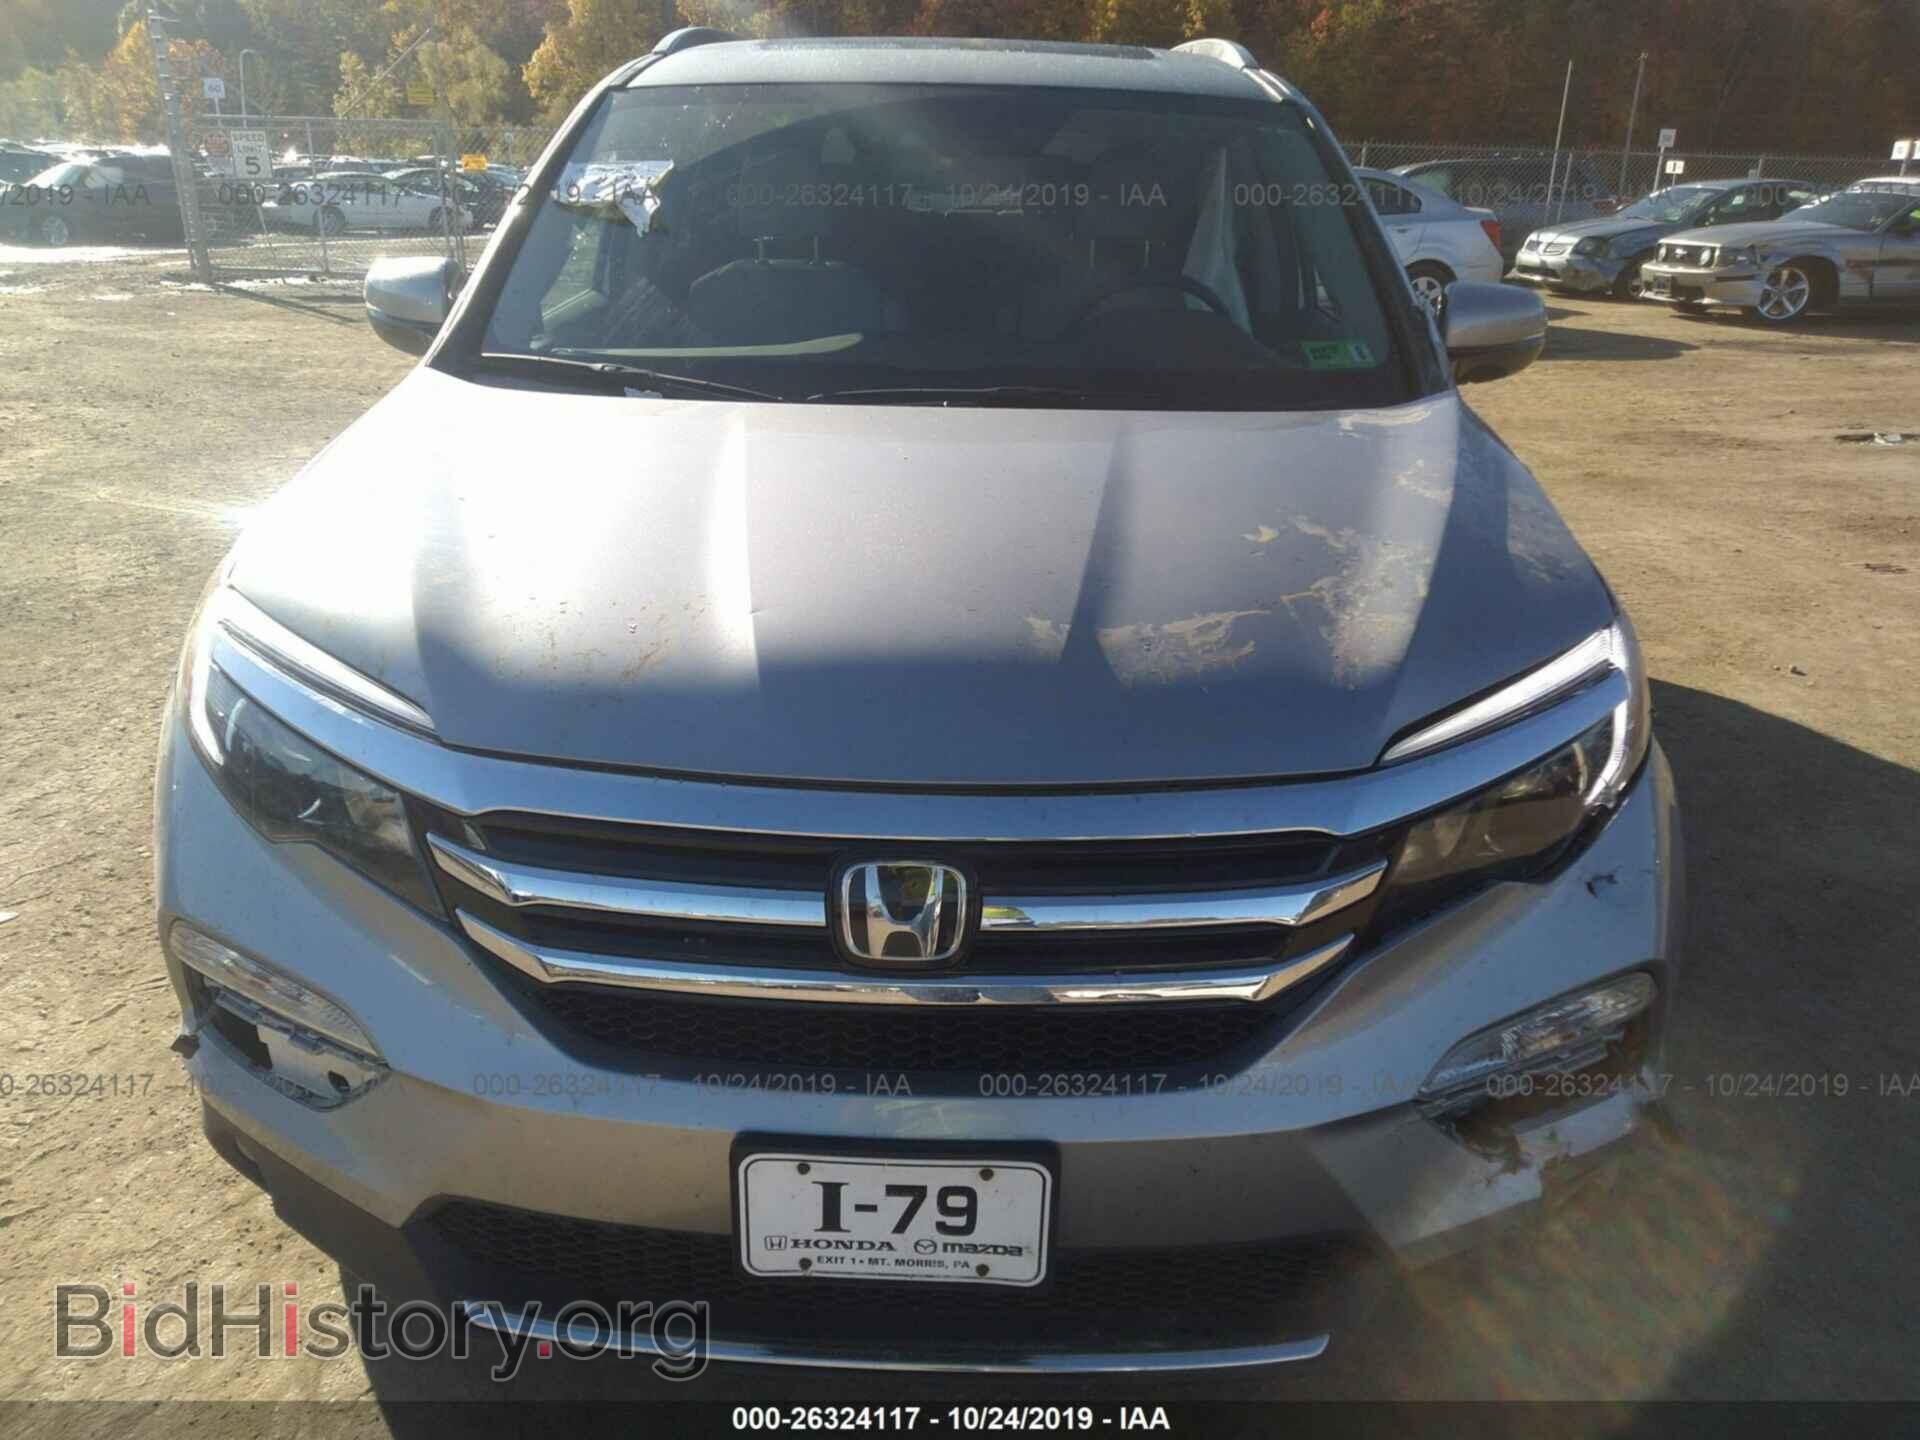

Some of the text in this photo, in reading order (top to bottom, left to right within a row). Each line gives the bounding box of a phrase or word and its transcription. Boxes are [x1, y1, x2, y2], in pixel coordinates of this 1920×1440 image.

[245, 156, 261, 175] 5
[811, 1181, 978, 1236] I-79
[790, 1238, 897, 1251] HONDA
[942, 1242, 1023, 1257] mazda
[816, 1256, 844, 1265] EXIT
[953, 1260, 971, 1269] PA
